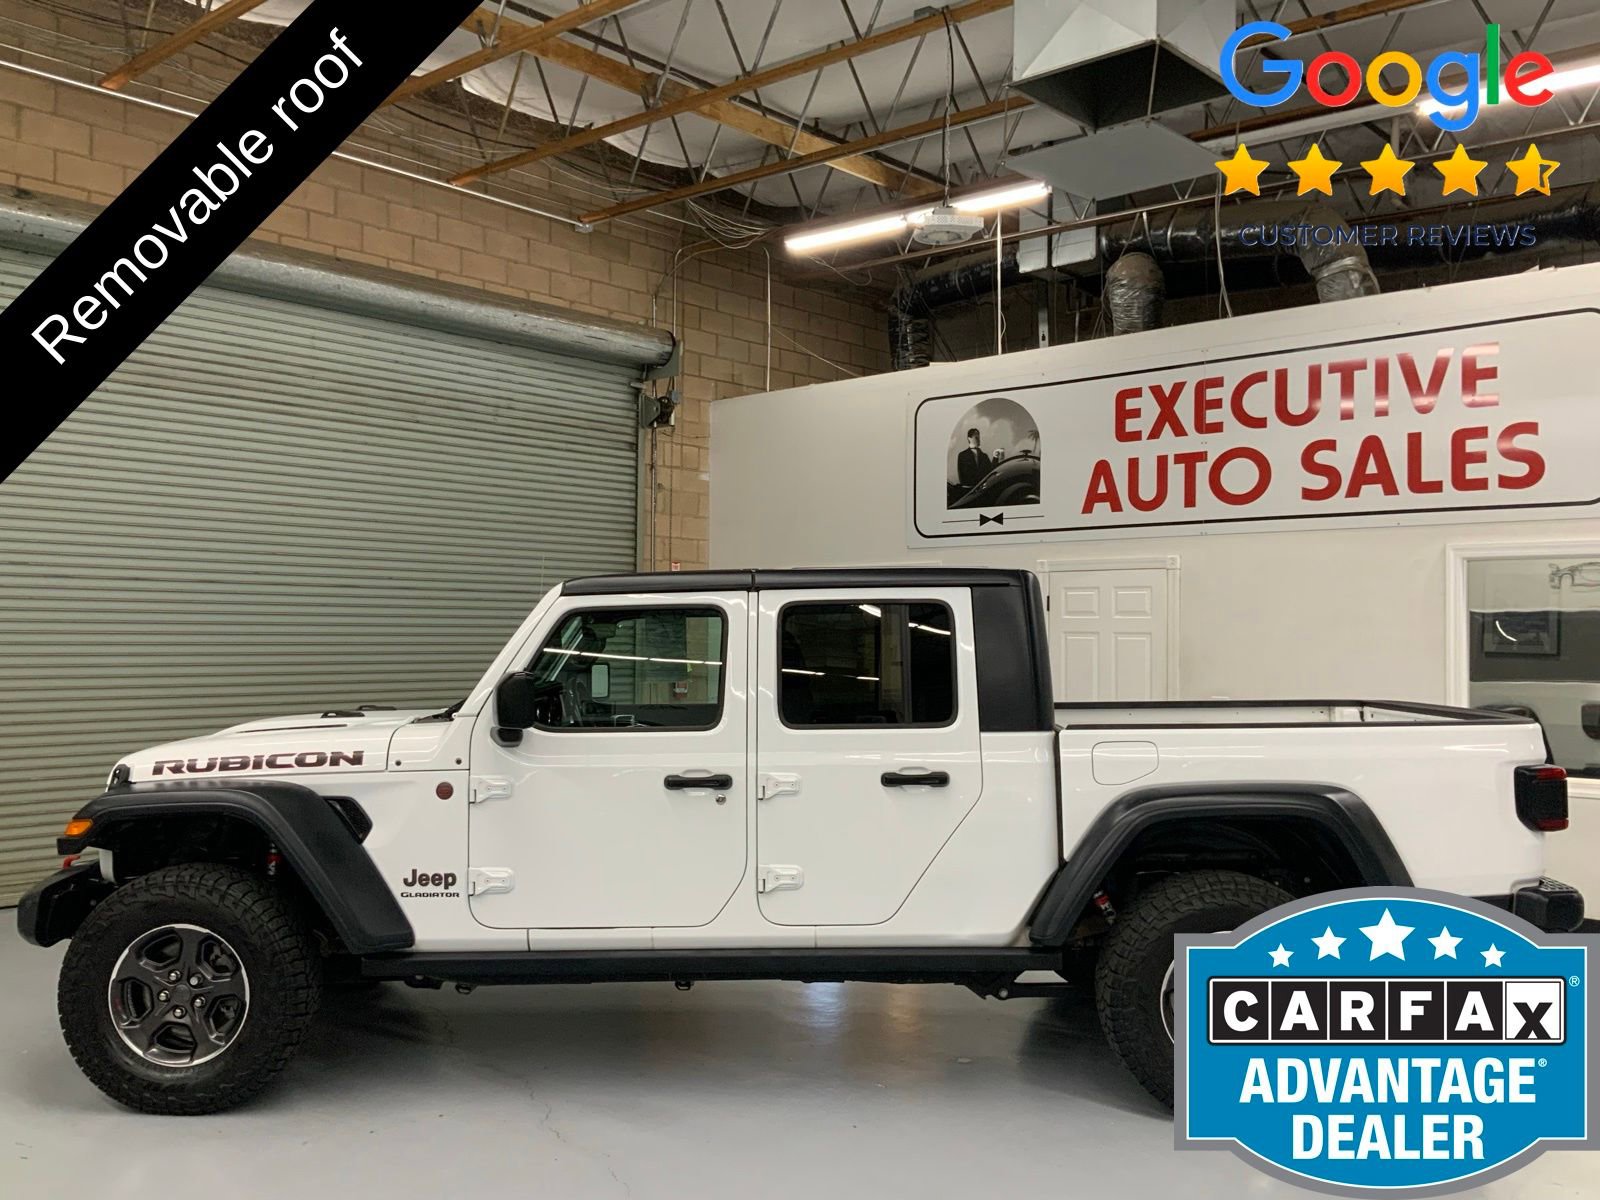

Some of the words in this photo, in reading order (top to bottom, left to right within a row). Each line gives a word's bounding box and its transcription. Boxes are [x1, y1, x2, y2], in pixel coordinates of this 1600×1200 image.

[1114, 341, 1501, 442] EXECUTIVE
[1081, 446, 1272, 515] AUTO
[1300, 421, 1546, 501] SALES
[152, 750, 365, 776] RUBICON
[403, 868, 457, 890] Jeep
